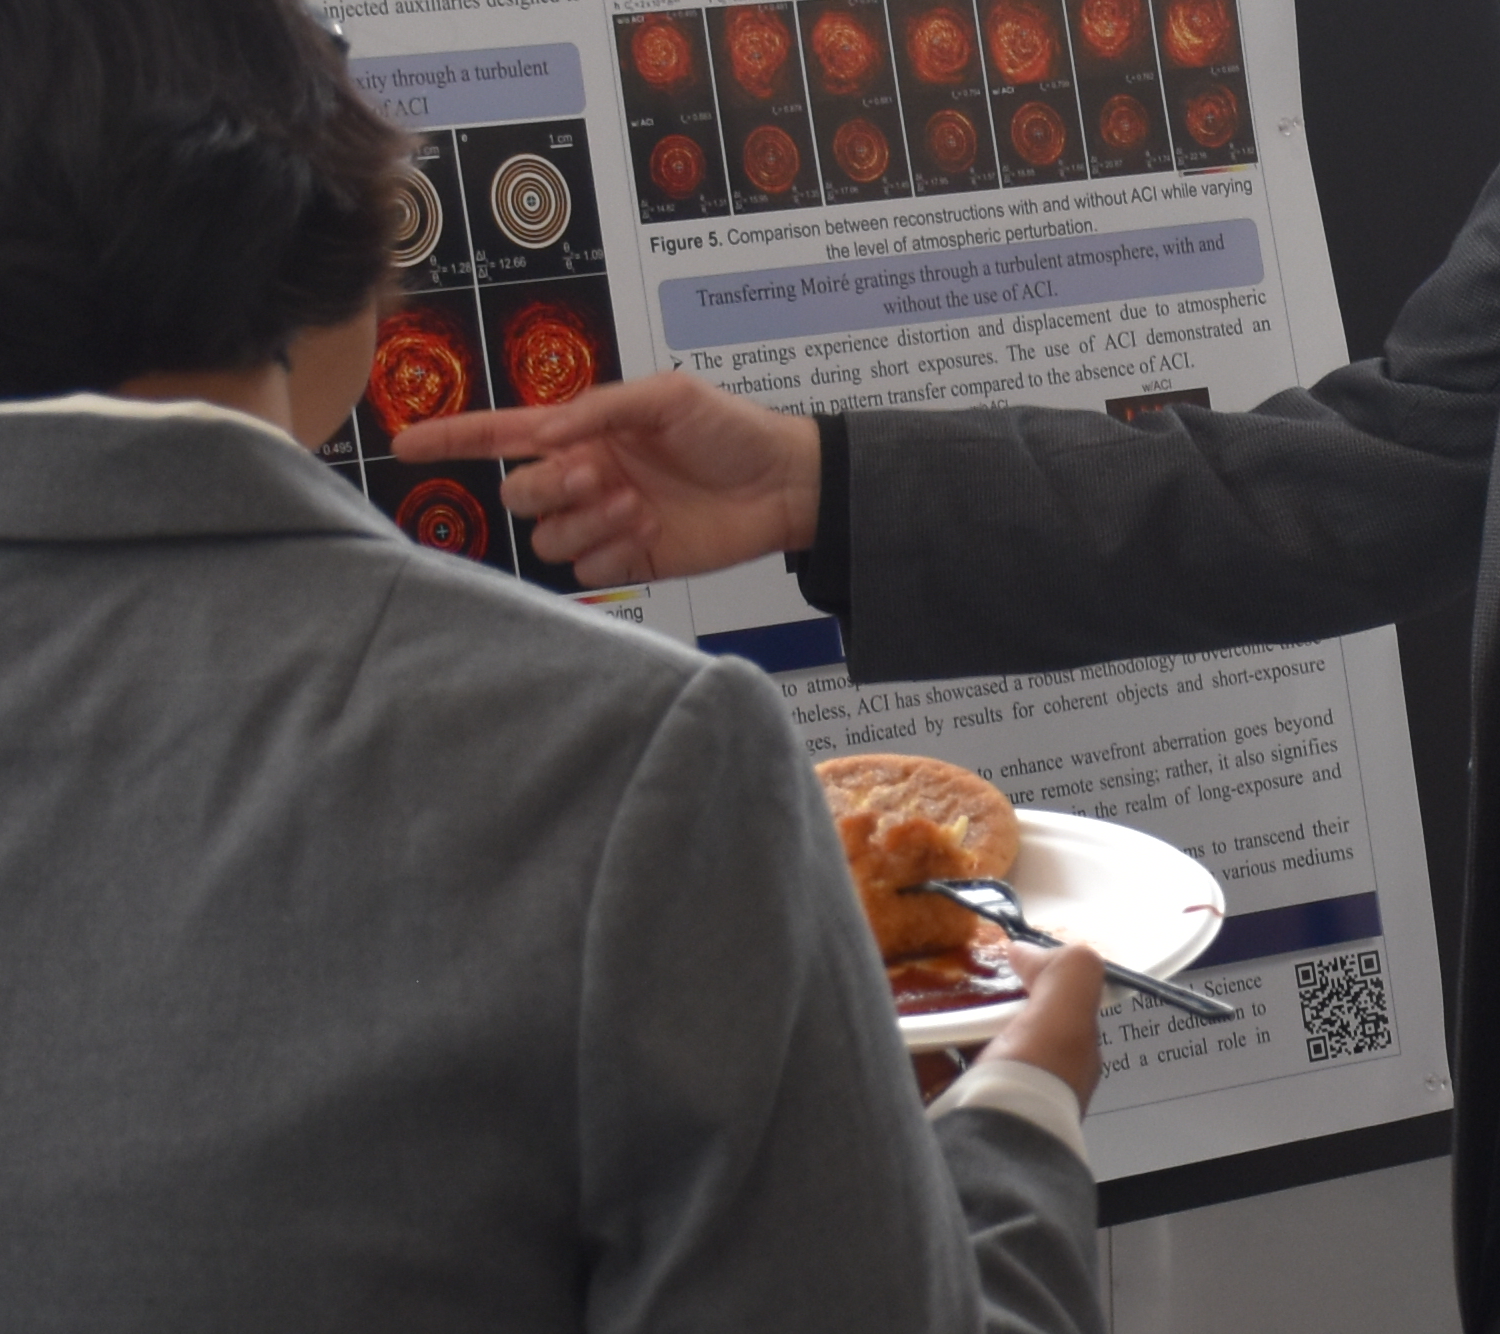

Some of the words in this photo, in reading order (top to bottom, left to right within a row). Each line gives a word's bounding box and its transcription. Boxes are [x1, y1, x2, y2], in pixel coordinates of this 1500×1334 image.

[650, 236, 703, 256] Figure
[709, 231, 723, 247] 5.
[727, 223, 820, 245] Comparison
[825, 217, 888, 235] between
[893, 206, 1004, 228] reconstructions
[1008, 199, 1038, 216] with
[1043, 195, 1070, 213] and
[1074, 190, 1128, 209] without
[1131, 186, 1157, 203] ACI
[1161, 183, 1197, 200] while
[1201, 178, 1252, 198] varying
[1141, 381, 1174, 393] w/ACI
